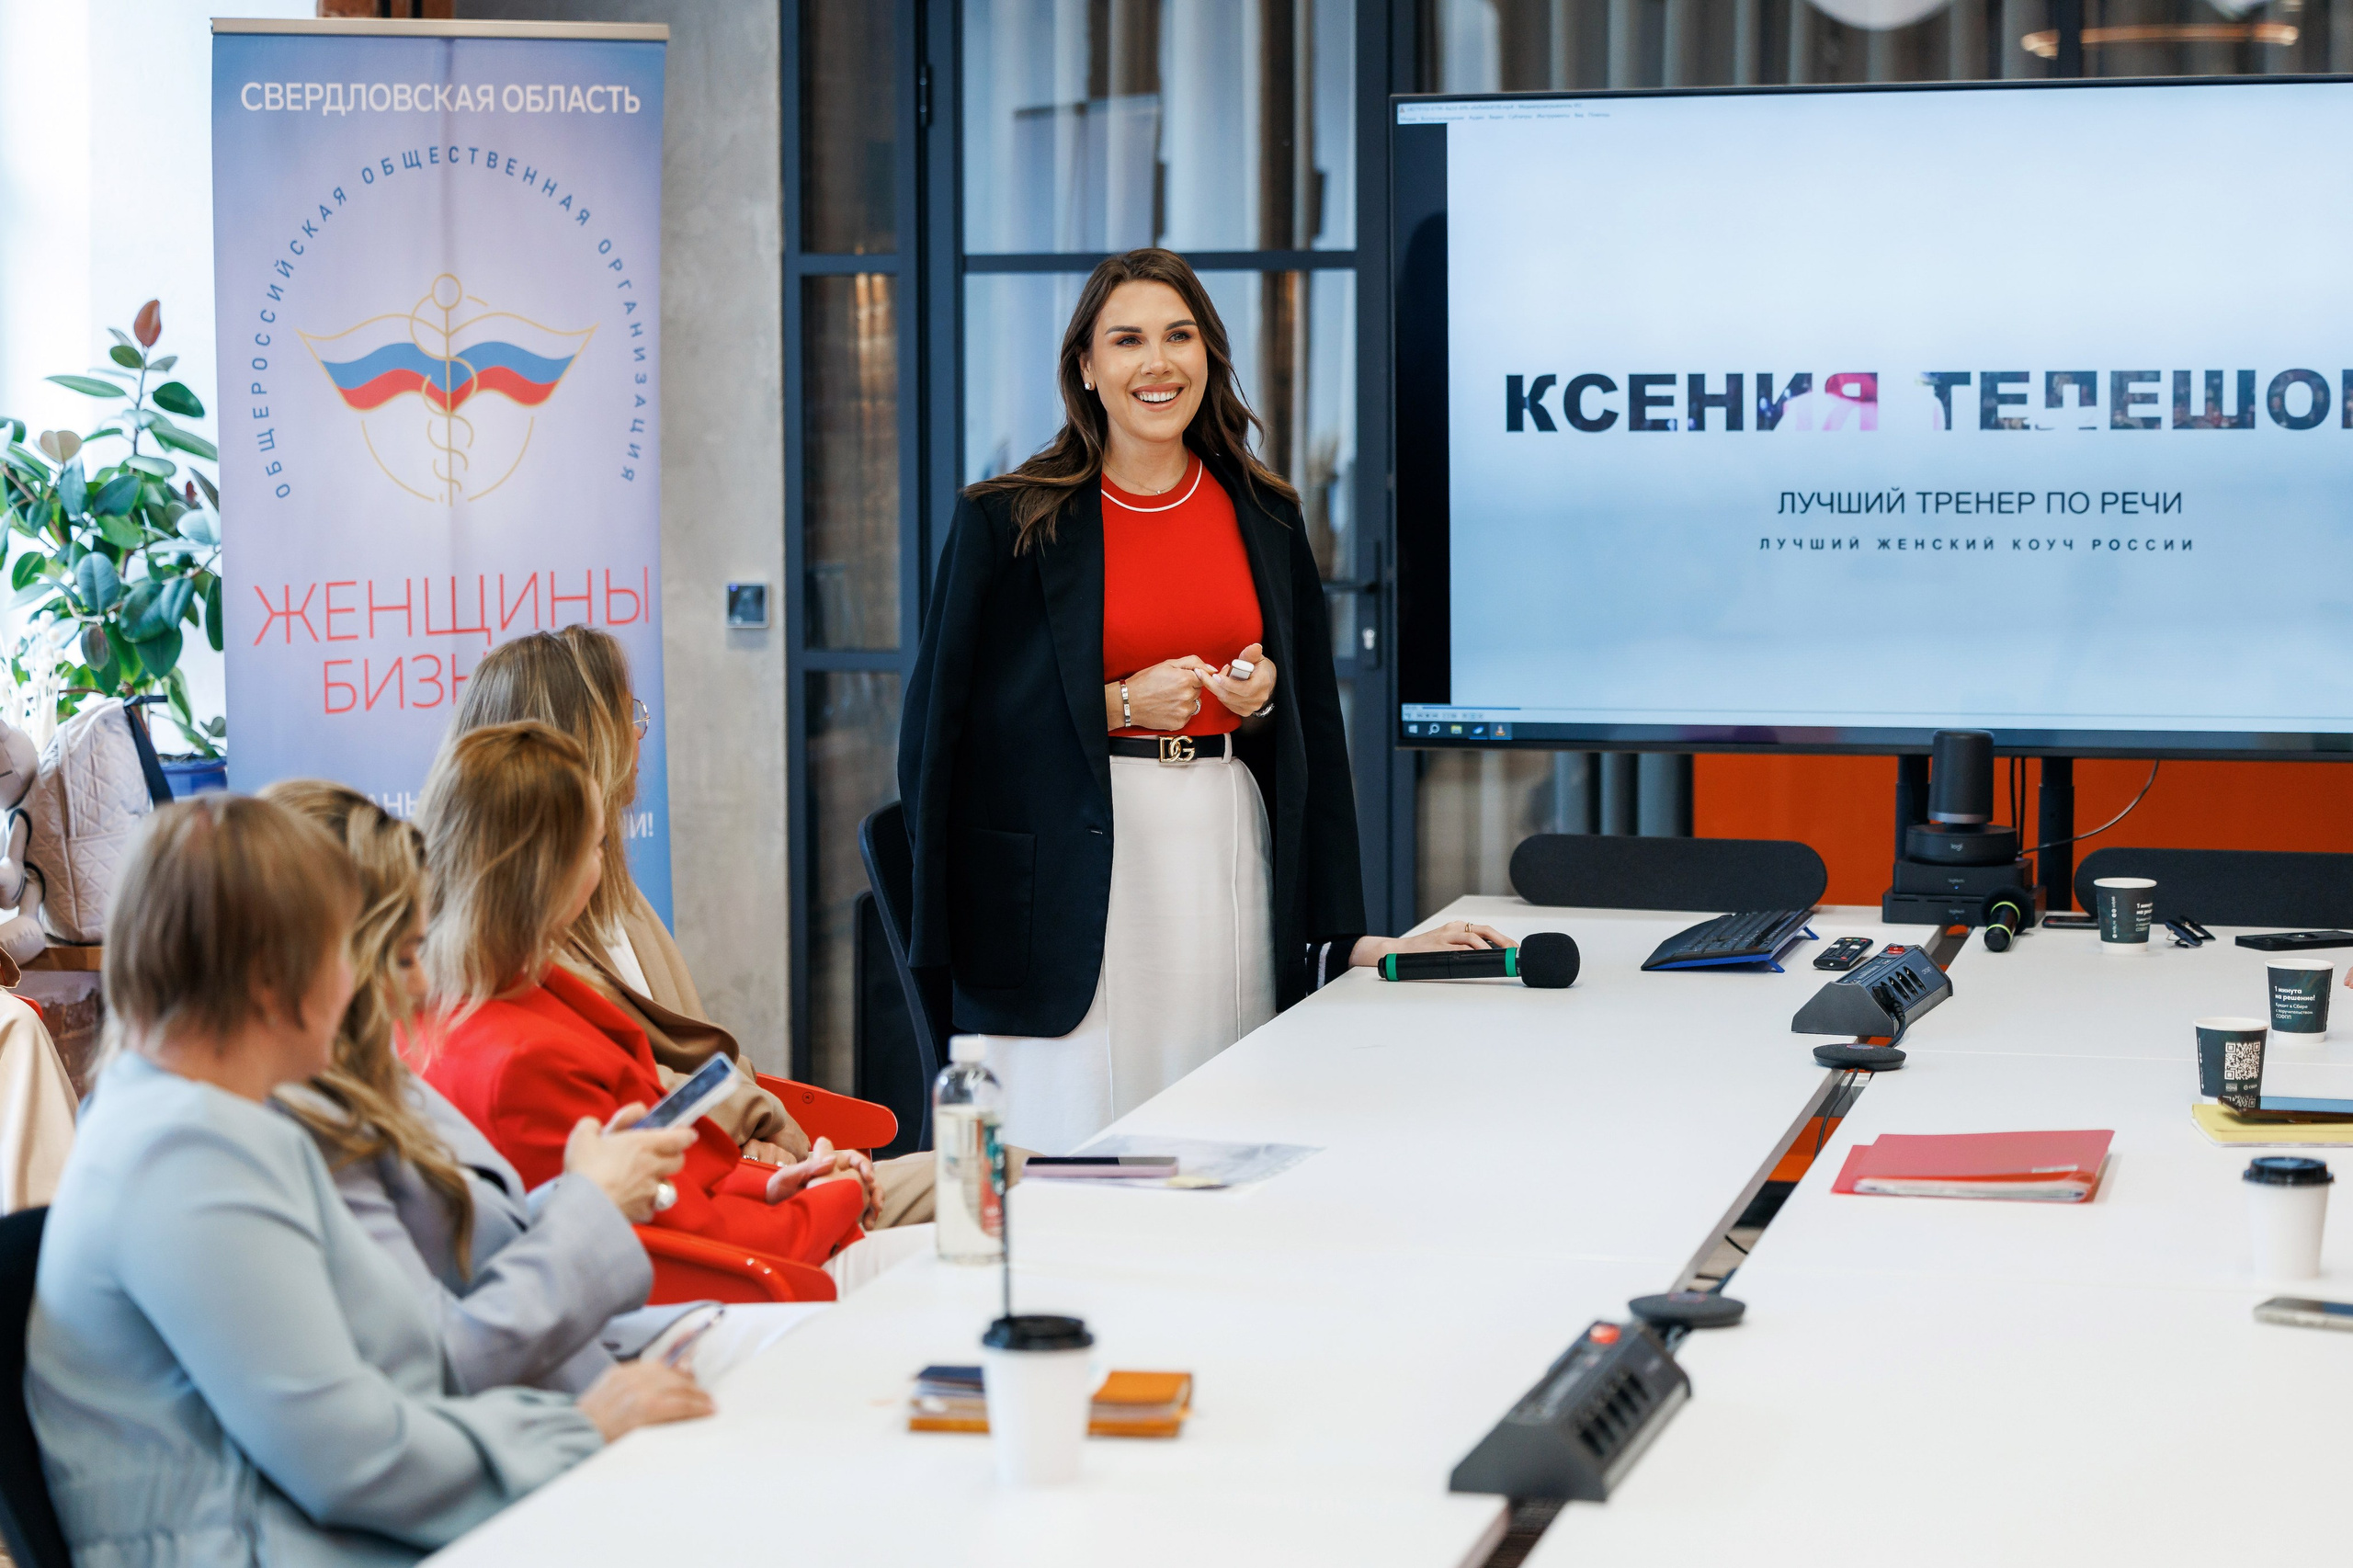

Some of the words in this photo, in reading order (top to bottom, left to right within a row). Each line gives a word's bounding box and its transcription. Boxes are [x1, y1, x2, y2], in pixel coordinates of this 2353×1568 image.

[240, 83, 494, 116] СВЕРДЛОВСКАЯ
[503, 85, 642, 115] ОБЛАСТЬ
[251, 187, 348, 499] ОБЩЕРОССИЙСКАЯ
[360, 145, 591, 226] ОБЩЕСТВЕННАЯ
[597, 238, 647, 482] ОРГАНИЗАЦИЯ
[1506, 371, 1879, 432] КСЕНИЯ
[1915, 368, 2353, 432] ТЕЛЕШО
[1777, 486, 1905, 515] ЛУЧШИЙ
[1915, 491, 2036, 515] ТРЕНЕР
[2046, 491, 2091, 515] ПО
[2101, 491, 2182, 515] РЕЧИ
[1758, 536, 1860, 551] ЛУЧШИЙ
[1877, 536, 1995, 551] ЖЕНСКИЙ
[2012, 538, 2074, 551] КОУЧ
[2092, 538, 2193, 551] РОССИИ
[253, 565, 650, 647] ЖЕНЩИНЫ
[2278, 987, 2302, 995] минута
